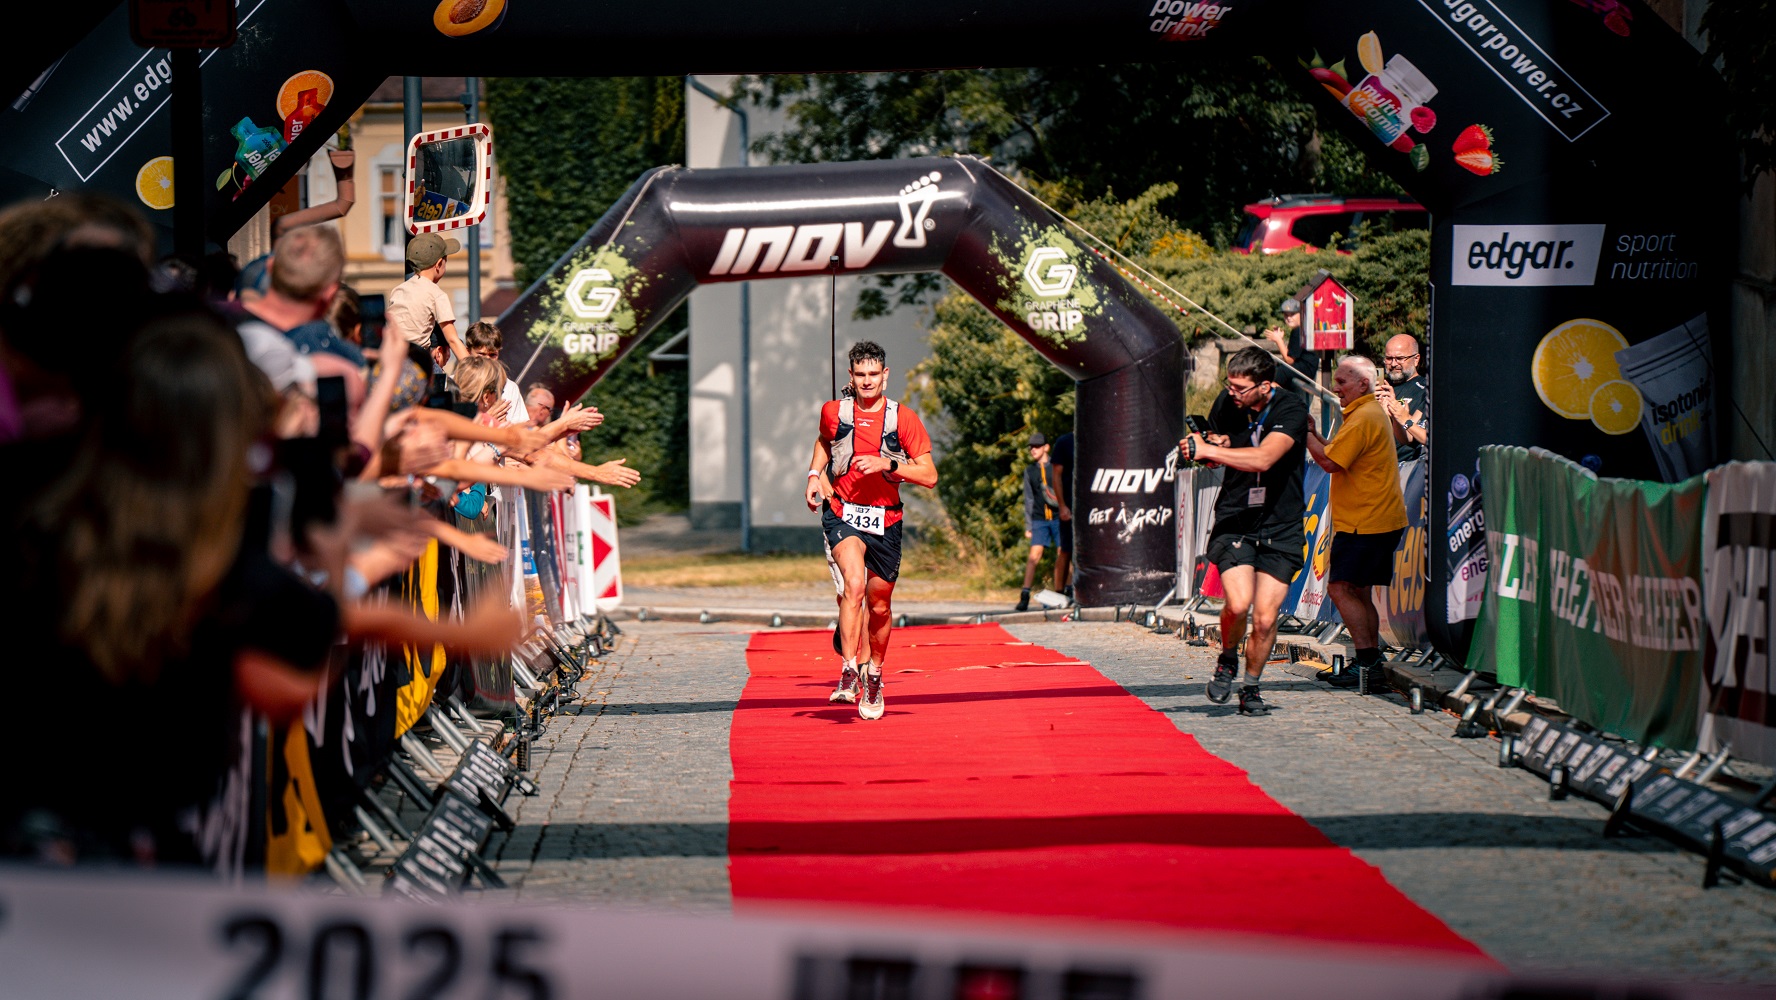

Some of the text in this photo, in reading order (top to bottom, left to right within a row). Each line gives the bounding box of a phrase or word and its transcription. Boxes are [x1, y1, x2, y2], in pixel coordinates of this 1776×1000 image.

[1149, 0, 1232, 20] power
[1149, 16, 1214, 37] drink
[80, 50, 172, 152] www.edg
[1361, 84, 1402, 116] multi
[1354, 93, 1399, 137] vitamin
[1616, 232, 1677, 257] sport
[1610, 258, 1699, 280] nutrition
[1024, 297, 1081, 311] GRAPHENE
[563, 321, 620, 332] GRAPHENE
[1026, 309, 1083, 331] GRIP
[563, 333, 620, 355] GRIP
[1650, 377, 1713, 426] isotonic
[845, 513, 880, 529] 2434
[1088, 507, 1114, 525] GET
[1115, 507, 1128, 524] A
[1450, 509, 1485, 552] energ
